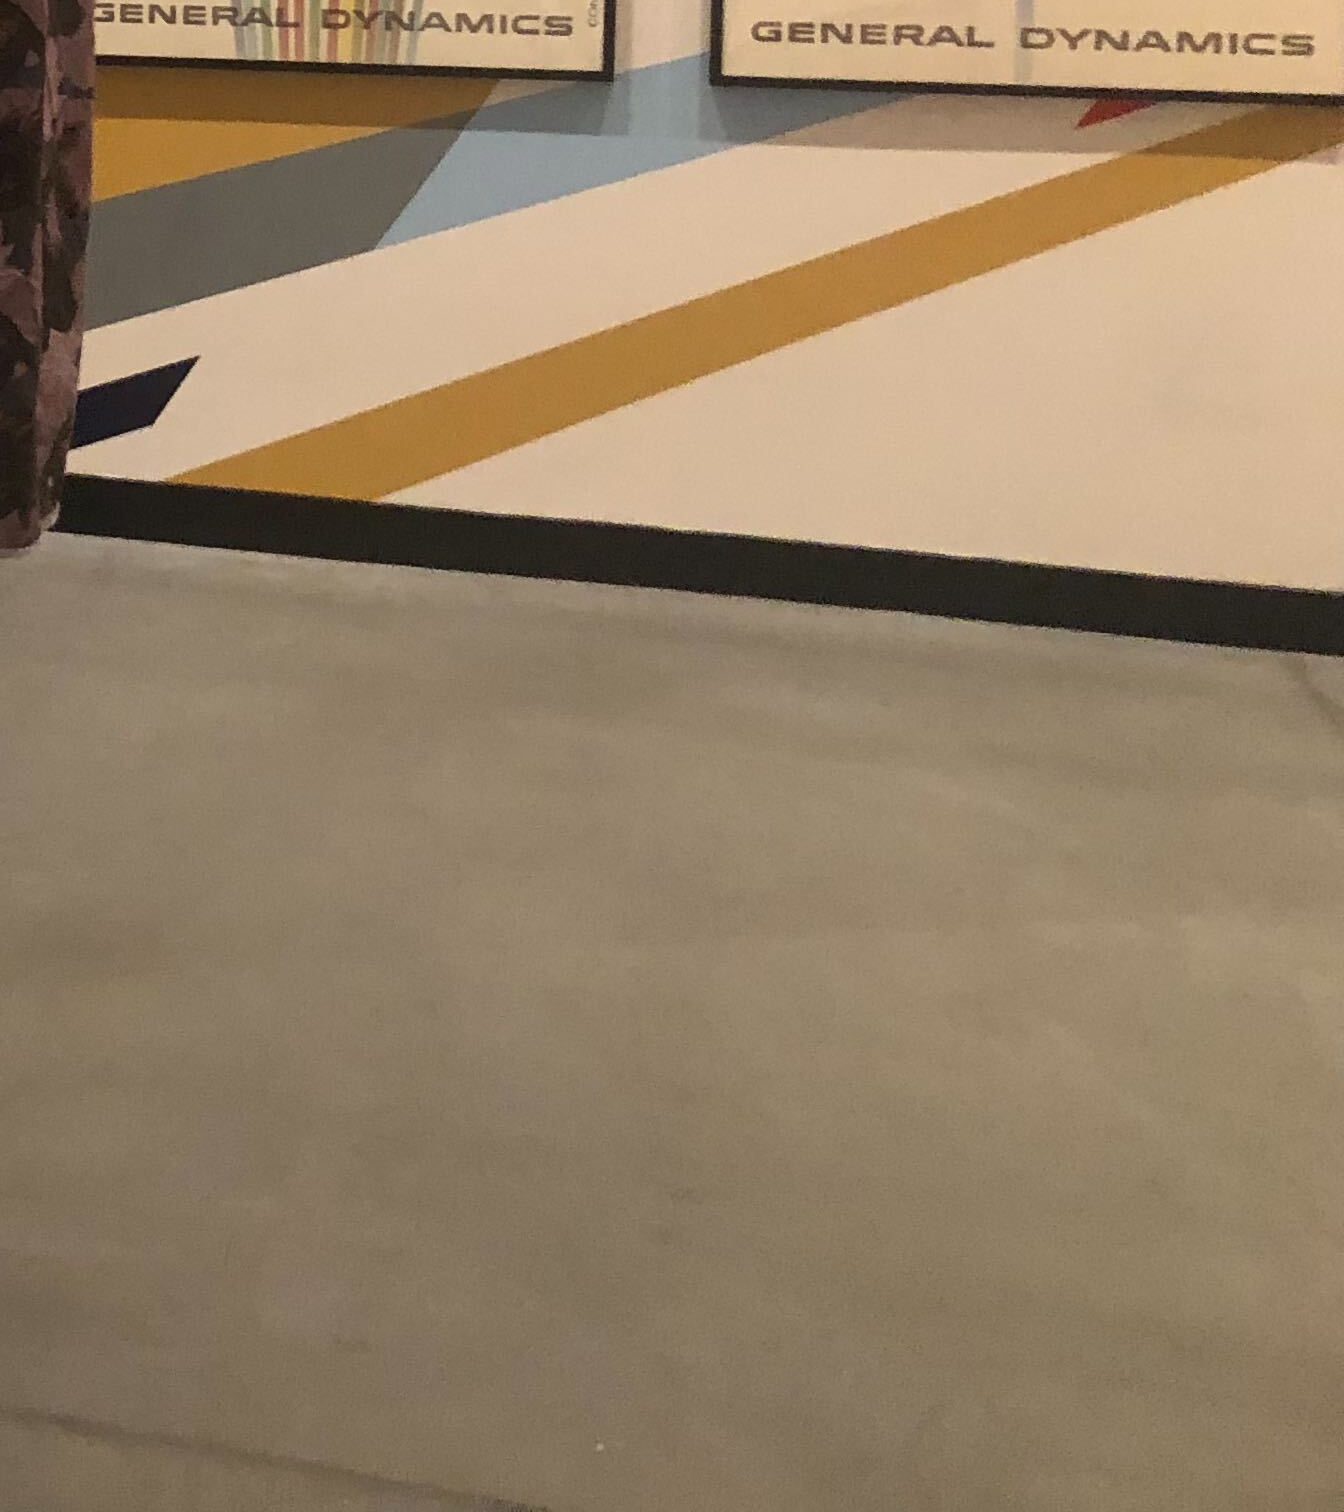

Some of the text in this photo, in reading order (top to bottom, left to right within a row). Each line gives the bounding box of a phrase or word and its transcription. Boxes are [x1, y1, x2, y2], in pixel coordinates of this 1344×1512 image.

[93, 2, 574, 37] GENERAL DYNAMICS
[750, 20, 1316, 57] GENERAL DYNAMICS
